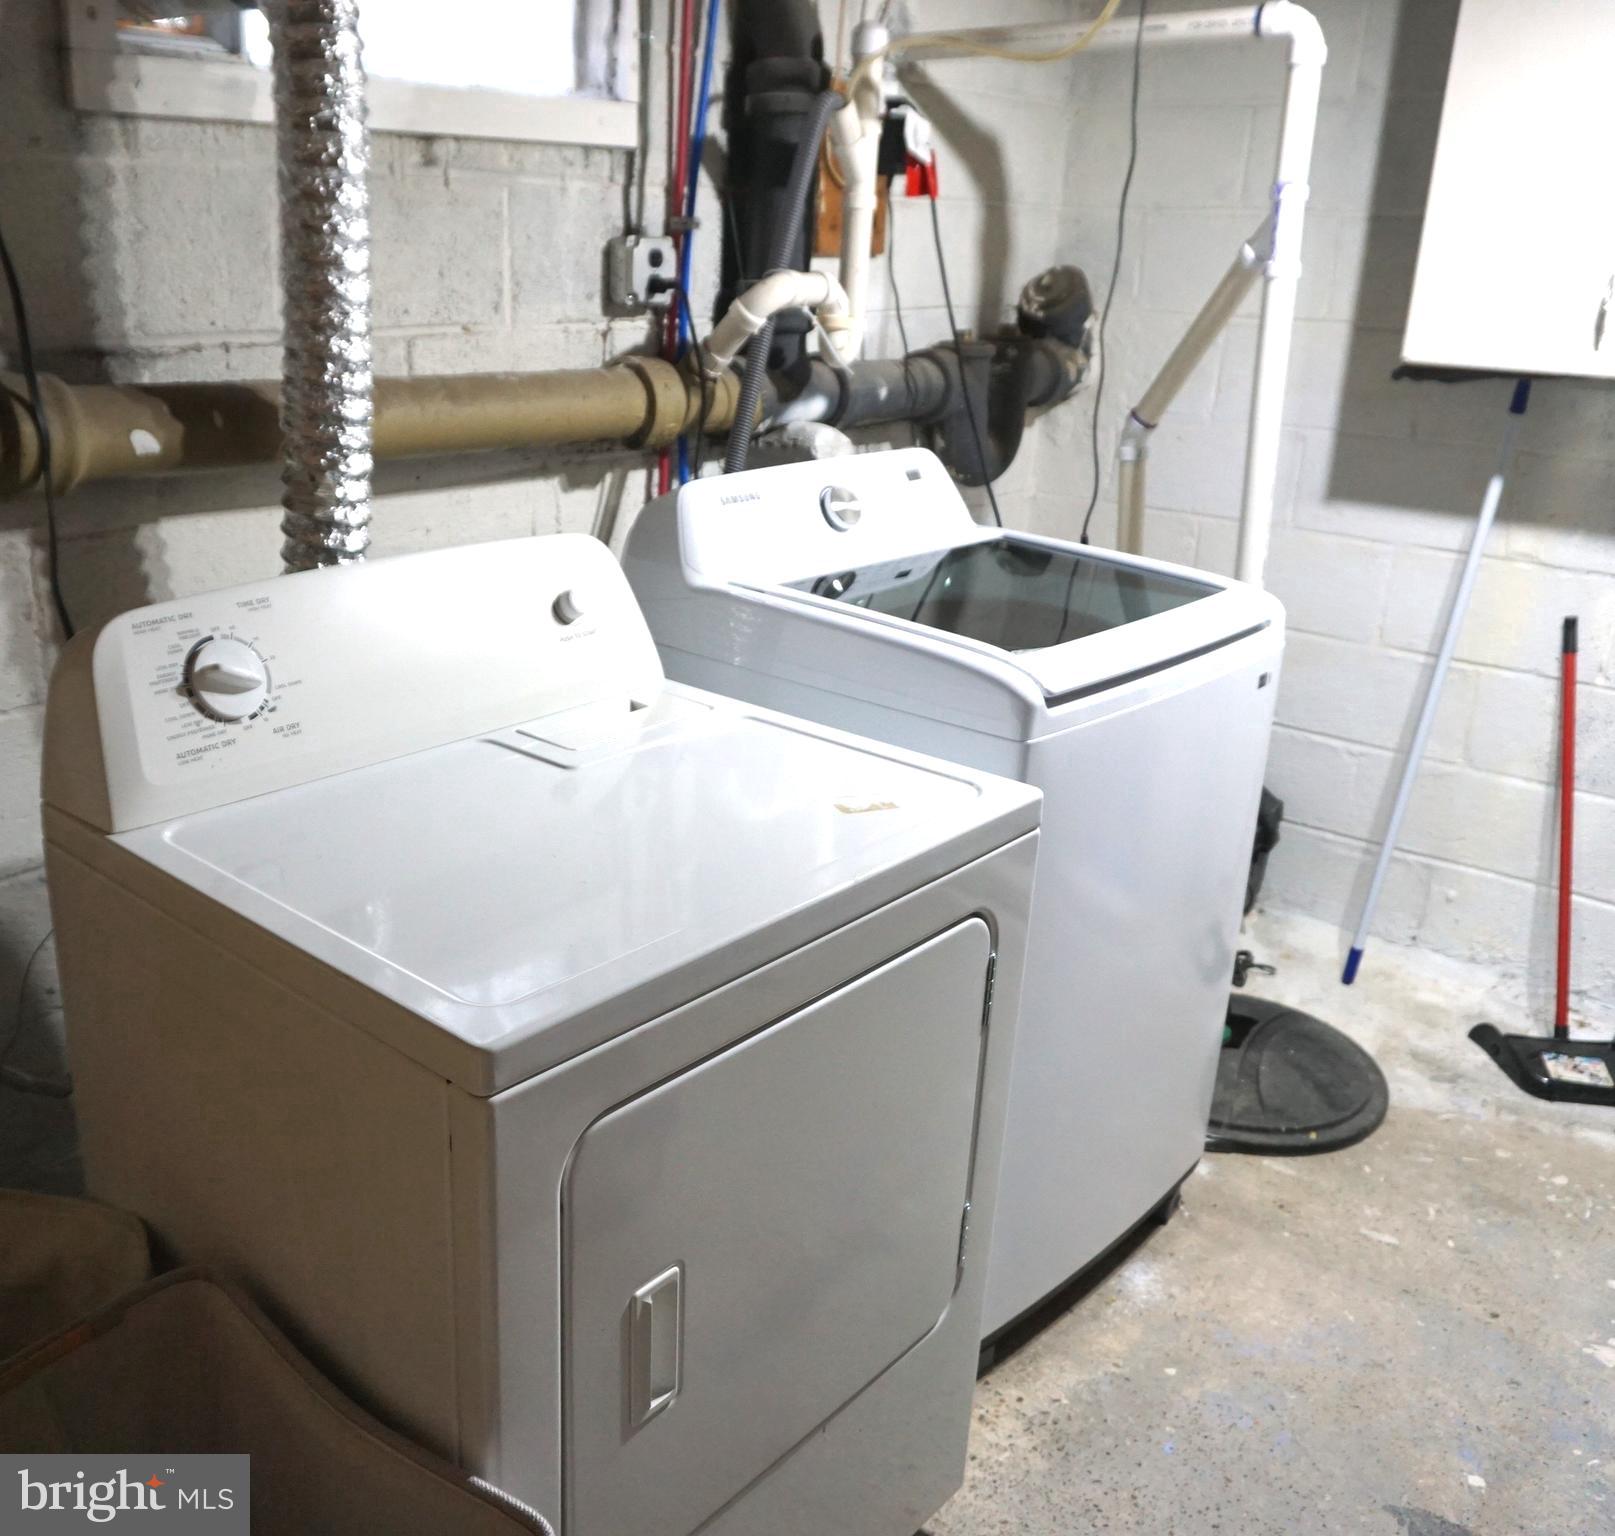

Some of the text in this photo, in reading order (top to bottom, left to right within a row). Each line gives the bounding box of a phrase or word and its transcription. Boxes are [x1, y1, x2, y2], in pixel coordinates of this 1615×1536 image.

[720, 493, 760, 506] SAMSUNG
[255, 596, 270, 605] DRY
[131, 612, 193, 630] AUTOMATIC DRY
[272, 722, 300, 735] AIR DRY
[176, 738, 237, 760] AUTOMATIC DRY
